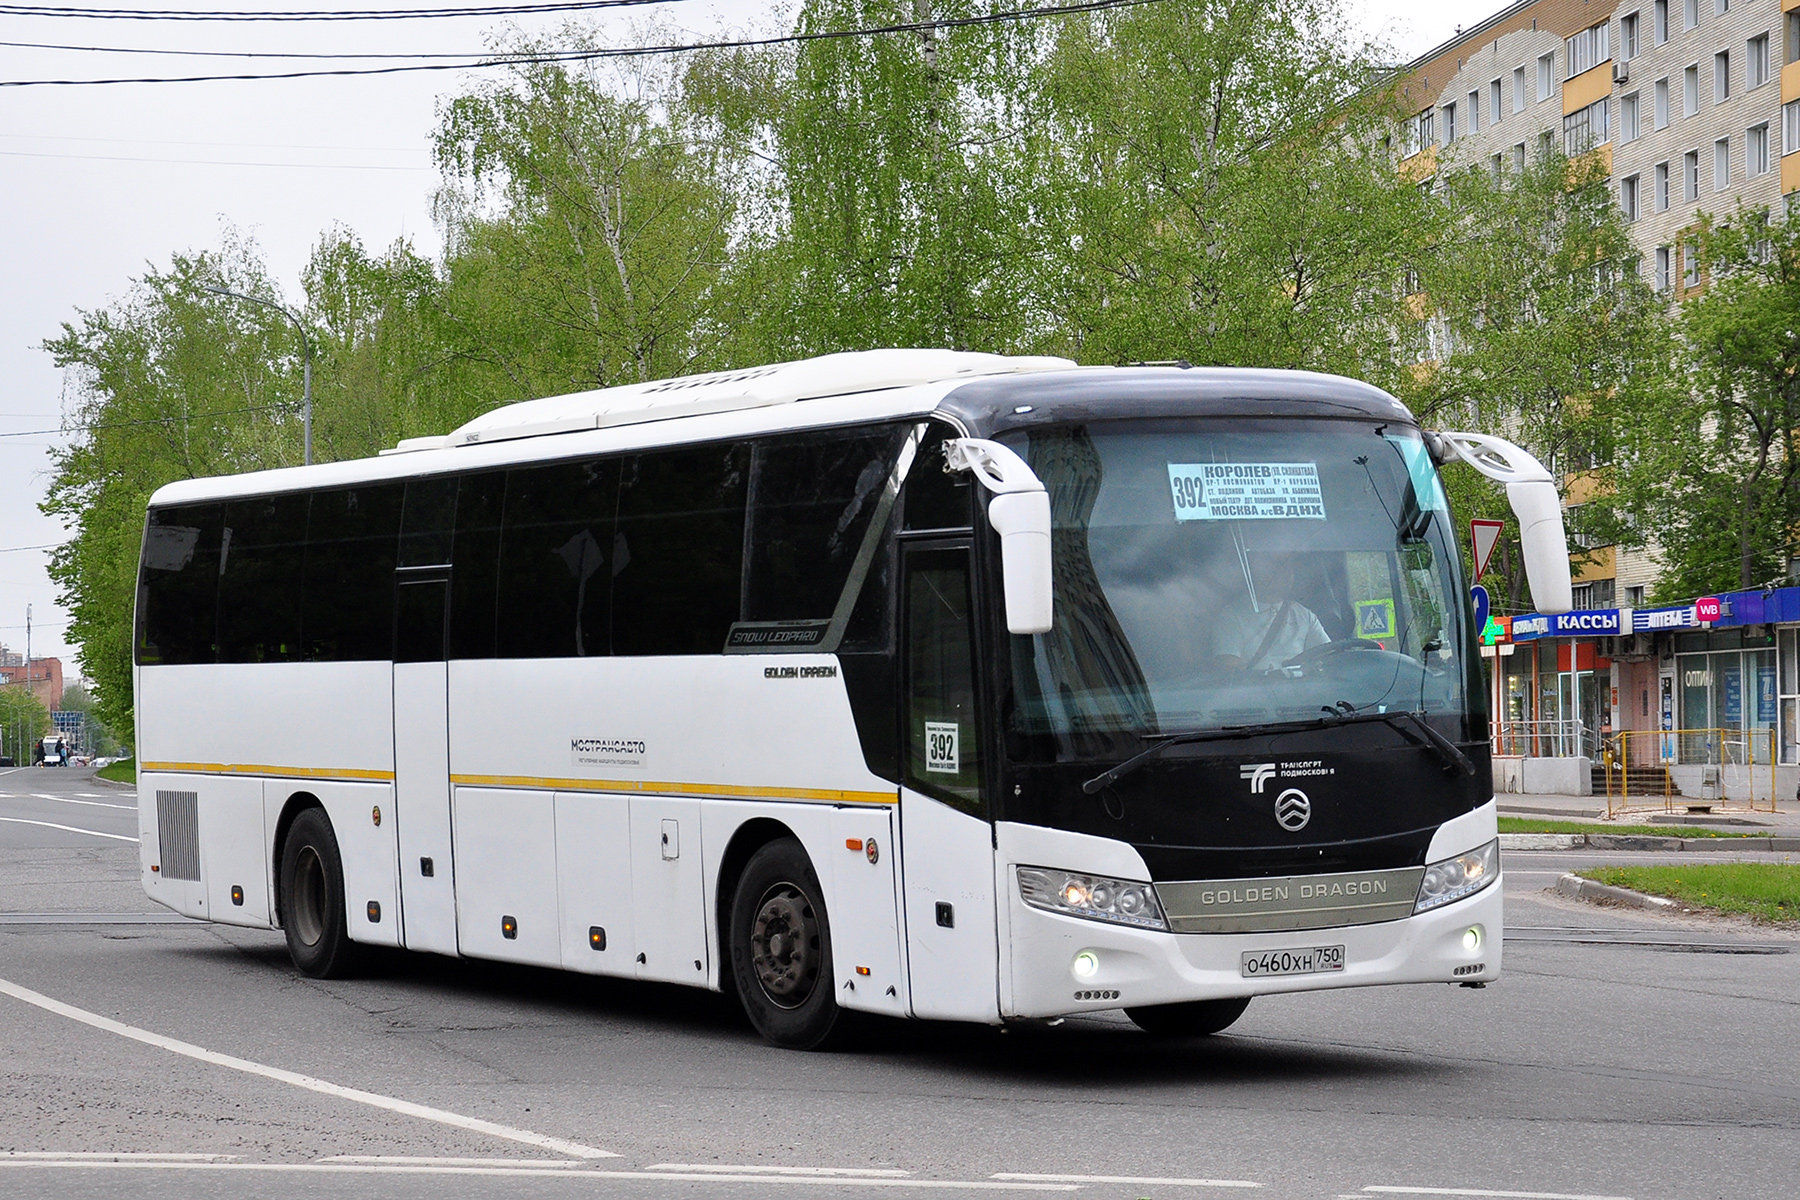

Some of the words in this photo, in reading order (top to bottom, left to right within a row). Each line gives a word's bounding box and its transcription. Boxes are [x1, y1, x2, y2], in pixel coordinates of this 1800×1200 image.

[1204, 465, 1271, 478] КОРОЛЕВ
[1173, 476, 1207, 508] 392
[1211, 506, 1258, 516] МОСКВА
[1272, 505, 1322, 516] ВДНХ
[1700, 604, 1718, 614] WB
[1557, 615, 1618, 630] КАССЫ
[732, 632, 766, 642] SNOW
[767, 630, 818, 642] LEOPARD
[571, 740, 645, 754] МОСТРАНСАВТО
[930, 734, 954, 760] 392
[1280, 760, 1322, 769] ТРАНСПОРТ
[1201, 886, 1289, 905] GOLDEN
[1300, 880, 1388, 898] DRAGON
[1316, 948, 1340, 964] 750
